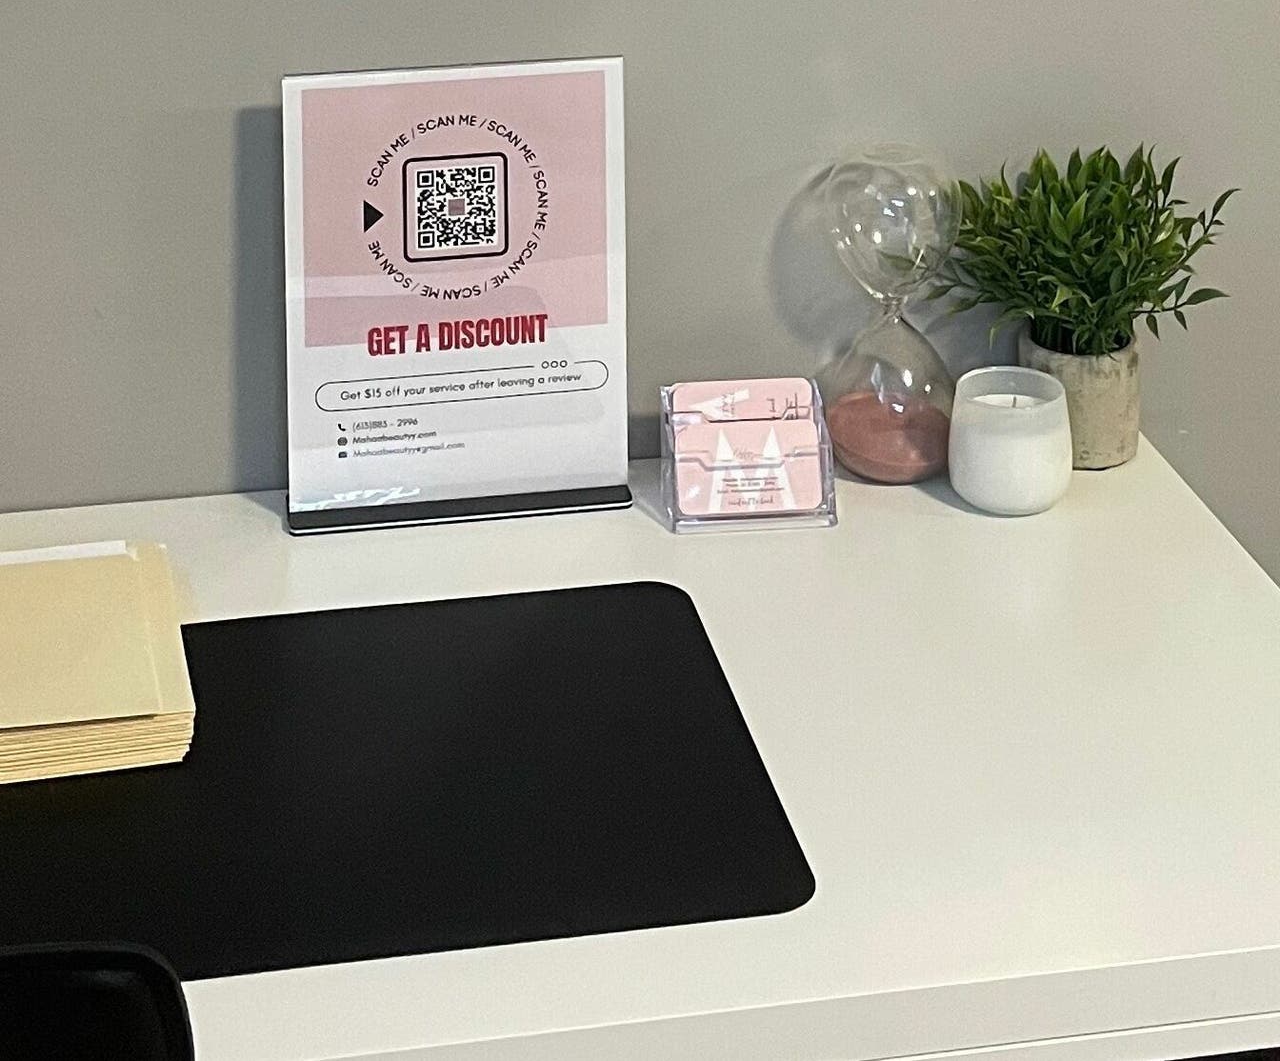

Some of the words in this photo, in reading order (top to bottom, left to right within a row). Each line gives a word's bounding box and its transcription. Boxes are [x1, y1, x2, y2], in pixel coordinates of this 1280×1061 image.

[417, 115, 455, 135] SCAN
[458, 114, 478, 126] ME
[390, 133, 410, 153] ME
[487, 120, 523, 148] SCAN
[518, 143, 537, 164] ME
[367, 149, 393, 188] SCAN
[533, 170, 550, 209] SCAN
[534, 210, 548, 231] ME
[368, 240, 386, 261] ME
[508, 239, 538, 276] SCAN
[379, 258, 413, 289] SCAN
[490, 270, 510, 289] ME
[420, 284, 440, 300] ME
[442, 284, 482, 300] SCAN
[367, 325, 409, 356] GET
[416, 324, 431, 353] A
[439, 313, 548, 351] DISCOUNT
[340, 390, 361, 401] Get
[364, 387, 381, 400] $15
[385, 385, 400, 398] off
[403, 385, 426, 398] your
[429, 382, 465, 394] service
[468, 378, 494, 391] after
[497, 375, 535, 391] leaving
[537, 376, 545, 384] a
[548, 373, 582, 384] review
